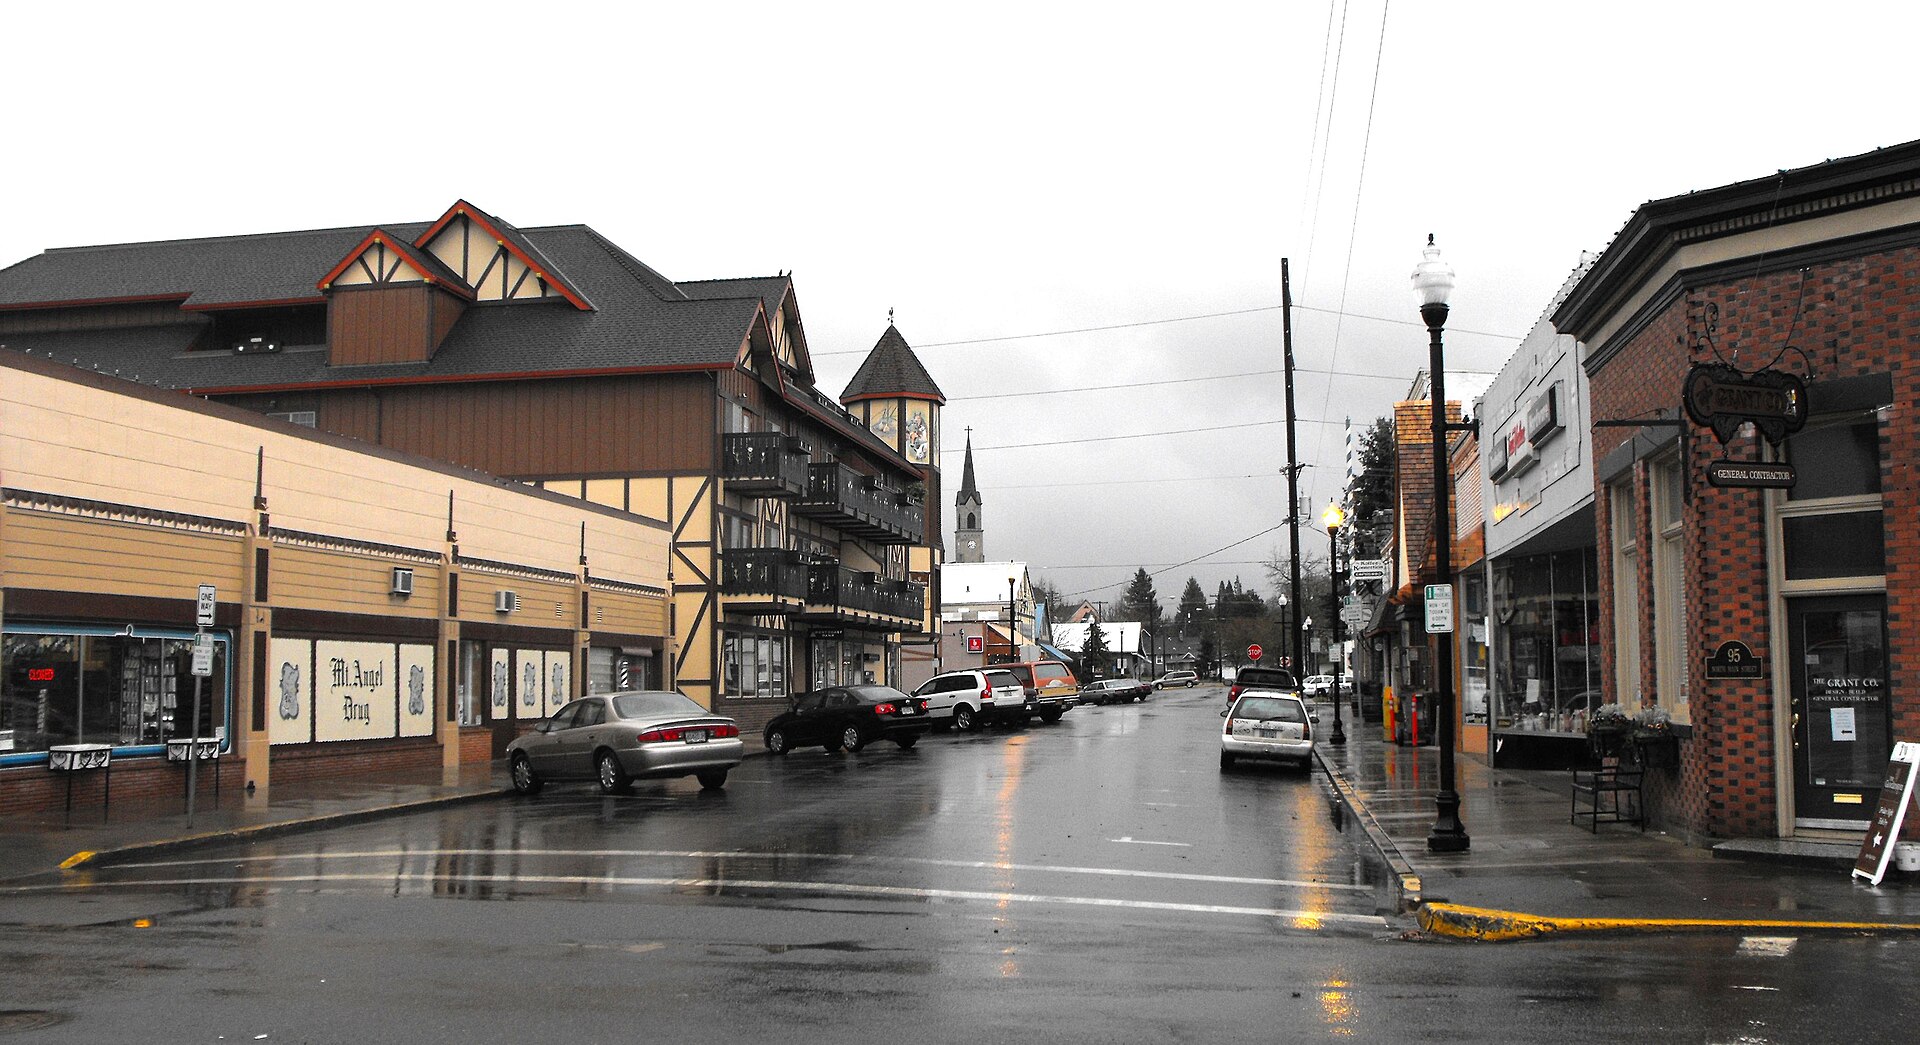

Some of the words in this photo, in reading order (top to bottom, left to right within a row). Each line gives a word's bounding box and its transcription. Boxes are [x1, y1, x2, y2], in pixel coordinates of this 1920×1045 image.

[1717, 469, 1748, 479] GENERAL
[1749, 470, 1790, 480] CONTRACTOR
[200, 593, 213, 602] ONE
[200, 603, 213, 611] WAY
[1727, 648, 1741, 663] 95
[329, 657, 352, 694] Mt.
[353, 660, 383, 692] Angel
[1813, 677, 1825, 685] THE
[1827, 678, 1859, 688] GRANT
[1862, 678, 1879, 687] CO.
[343, 695, 371, 725] Drug
